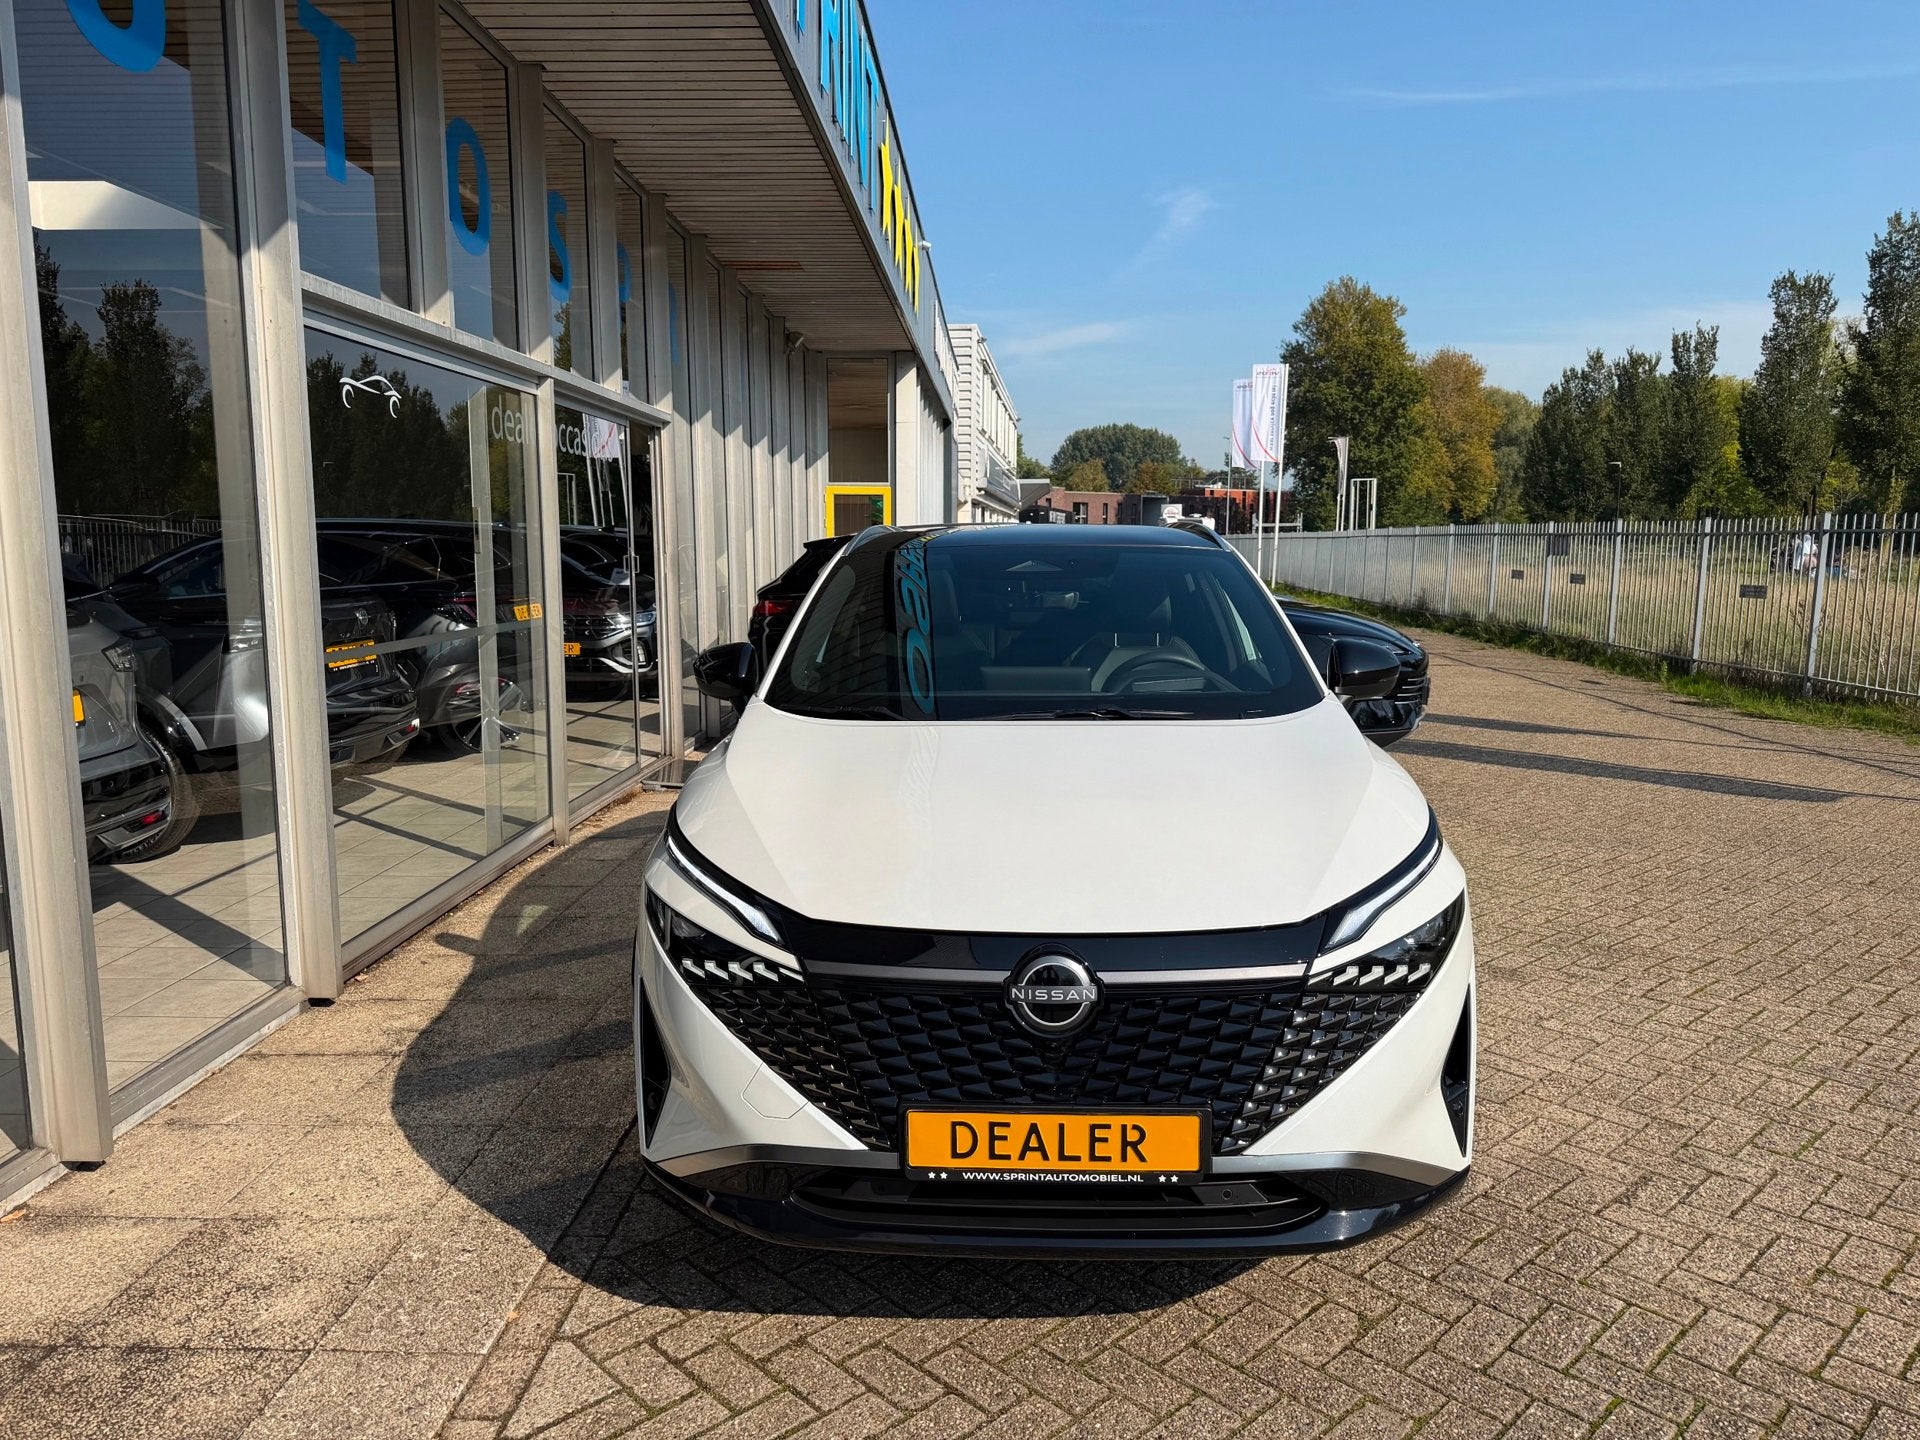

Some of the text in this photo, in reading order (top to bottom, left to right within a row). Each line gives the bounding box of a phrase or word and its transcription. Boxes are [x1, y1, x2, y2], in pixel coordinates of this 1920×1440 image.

[1011, 988, 1095, 1000] NISSAN
[950, 1120, 1148, 1163] DEALER
[962, 1171, 1144, 1183] WWW.SPRINTAUTOMOBIEL.NL
